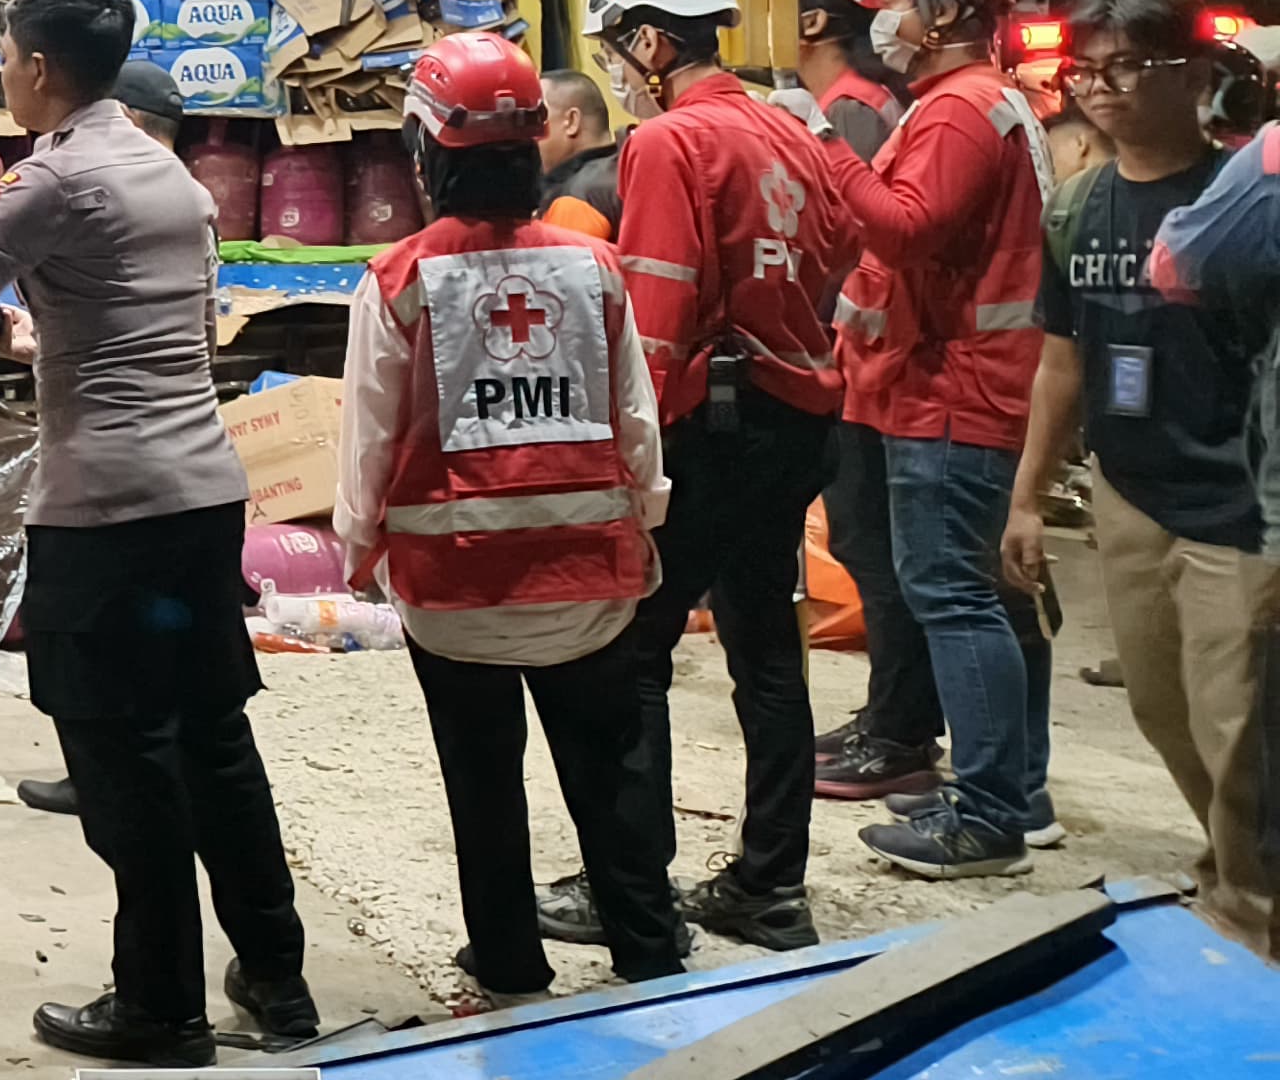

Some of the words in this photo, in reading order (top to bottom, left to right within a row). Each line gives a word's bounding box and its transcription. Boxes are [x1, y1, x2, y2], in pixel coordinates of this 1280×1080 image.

[188, 3, 244, 26] AQUA
[180, 62, 236, 85] AQUA
[474, 376, 570, 420] PMI
[227, 419, 250, 441] JAN
